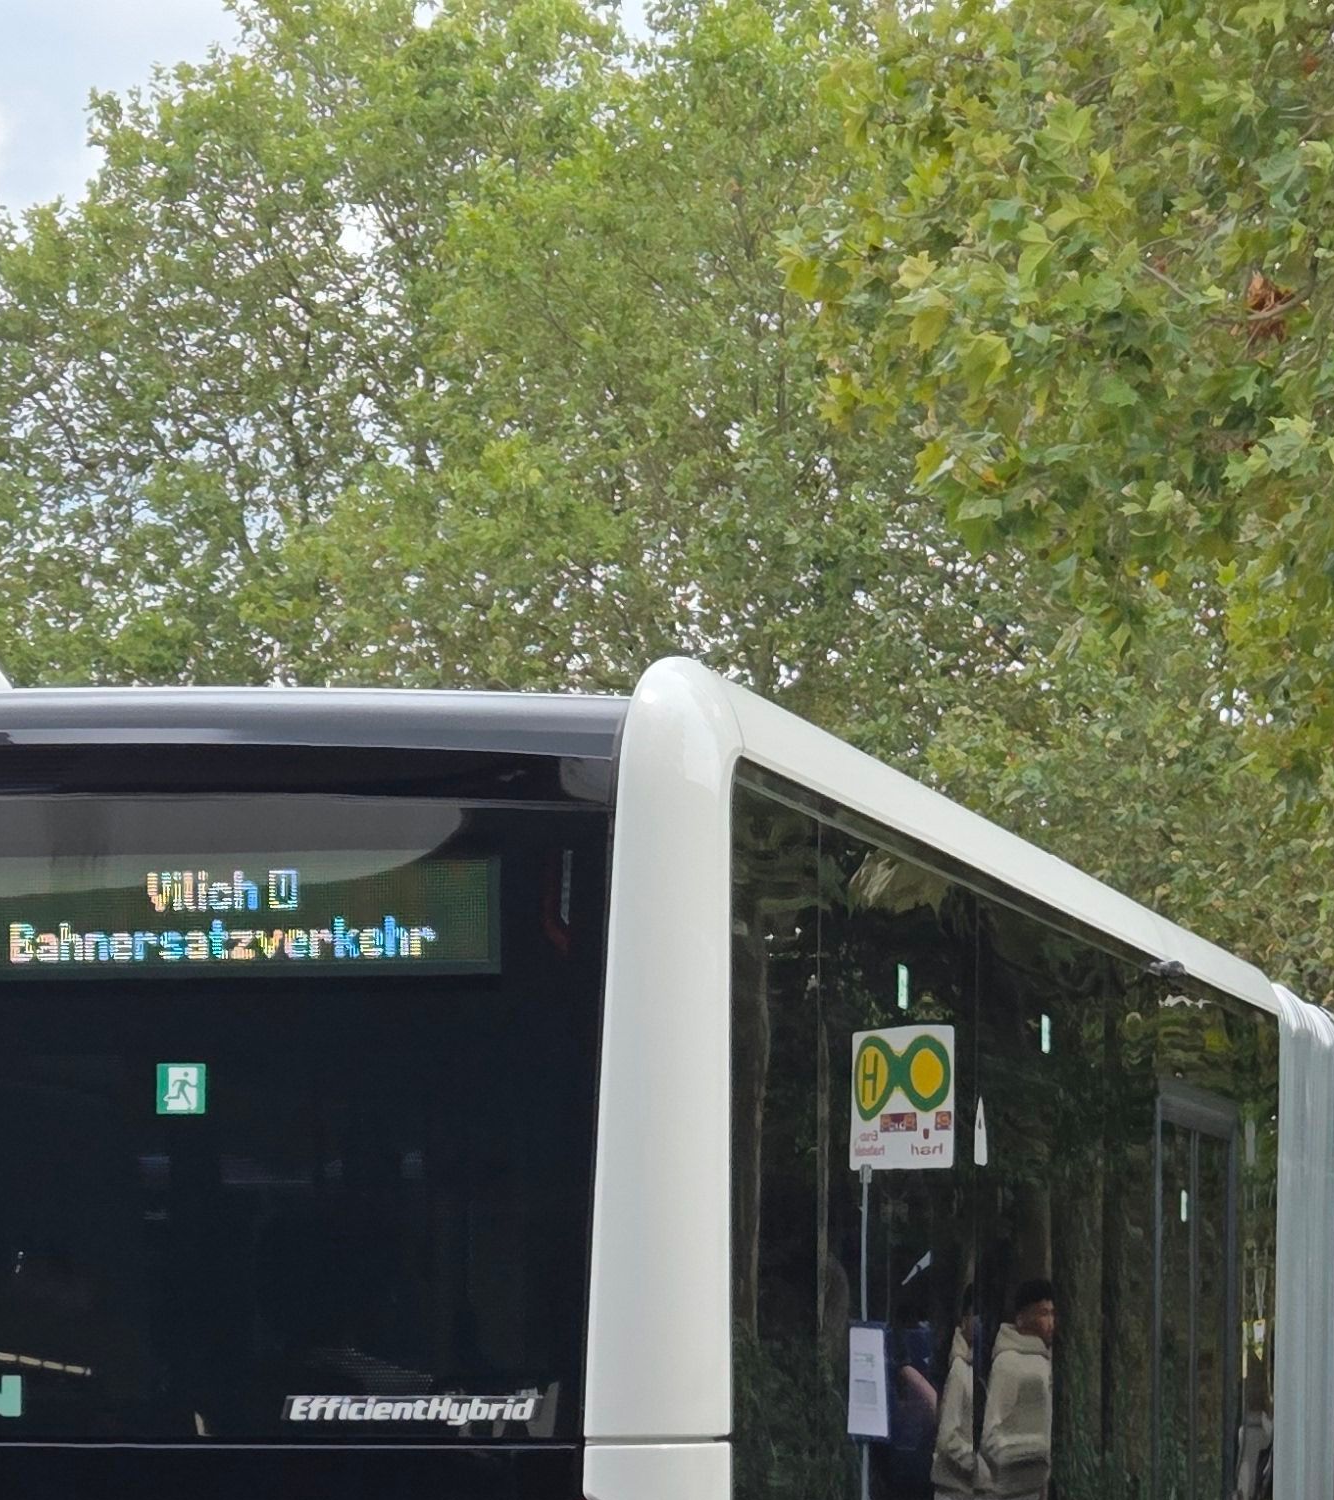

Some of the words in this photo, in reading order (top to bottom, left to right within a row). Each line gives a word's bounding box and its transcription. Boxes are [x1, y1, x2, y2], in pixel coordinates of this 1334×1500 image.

[147, 870, 259, 912] Vilich
[9, 915, 437, 964] Bahnersatzverkehr
[289, 1396, 535, 1425] EfficientHybrid
